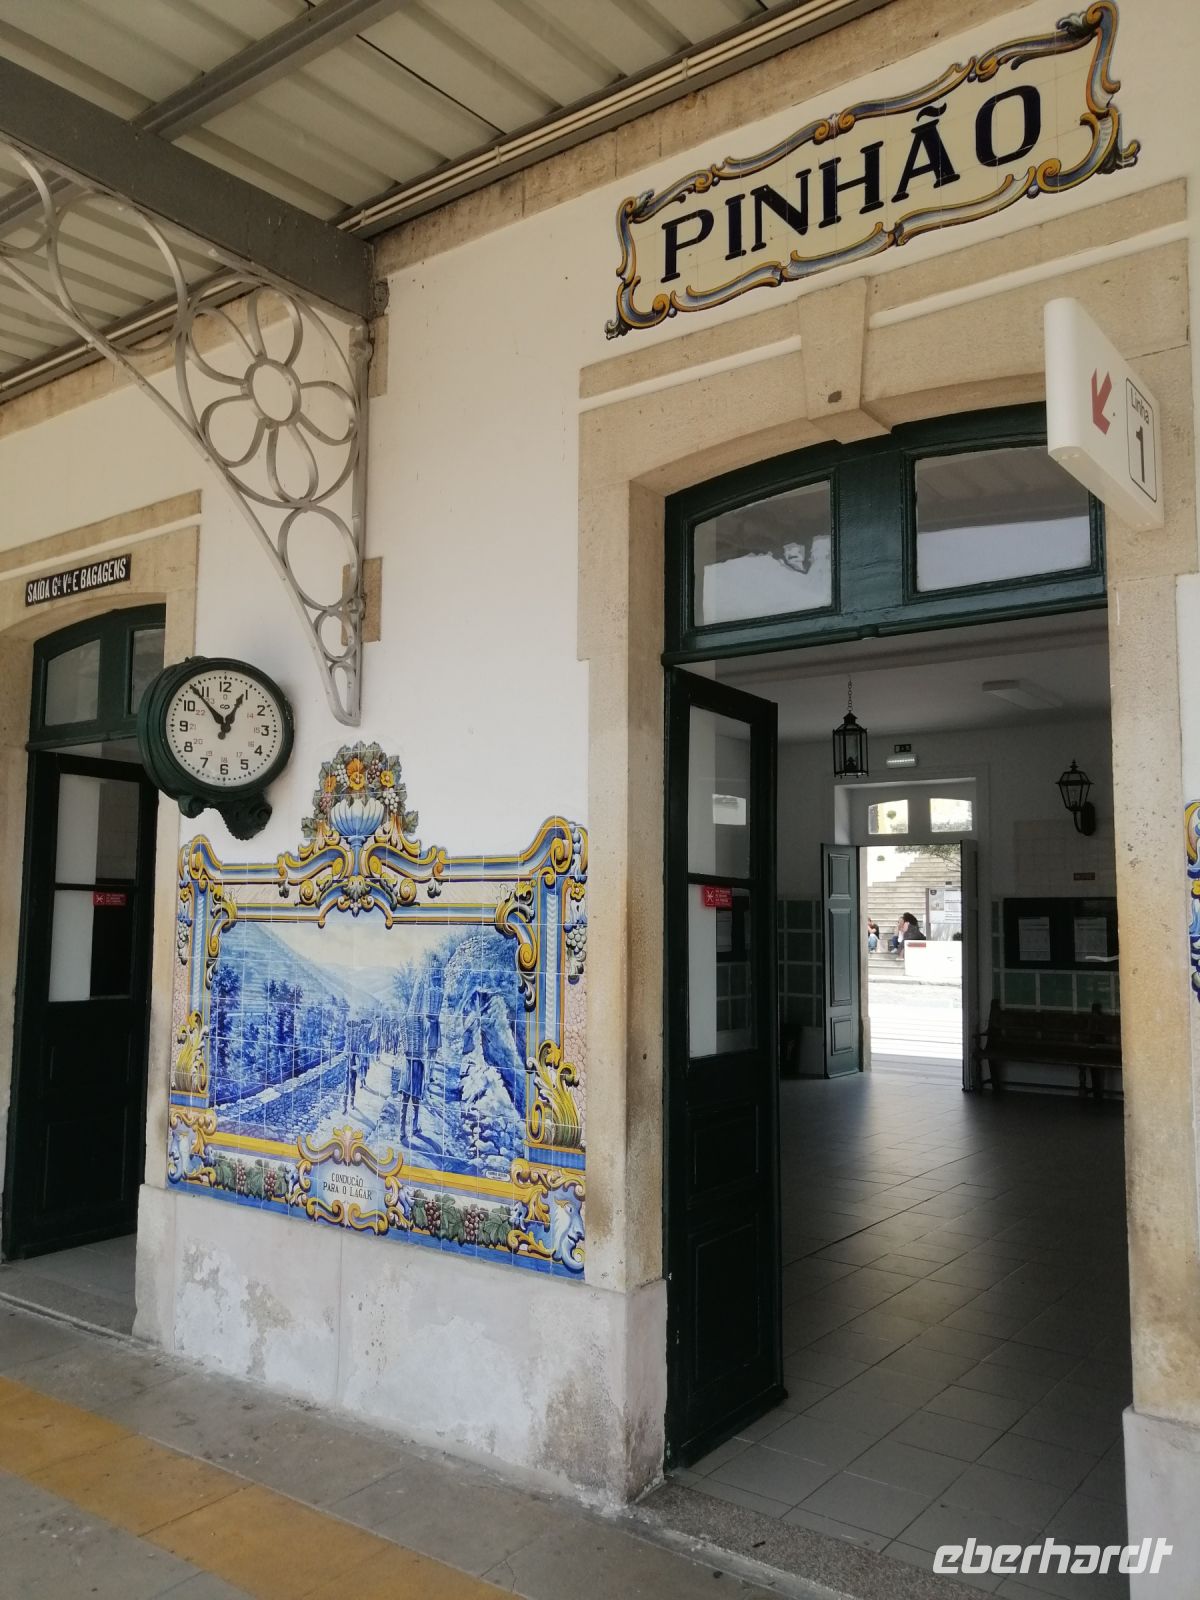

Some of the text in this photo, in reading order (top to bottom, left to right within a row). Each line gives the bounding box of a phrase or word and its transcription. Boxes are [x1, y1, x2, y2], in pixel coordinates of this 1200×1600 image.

[659, 83, 1043, 284] PINHÃO
[1130, 387, 1150, 426] Linha
[1135, 425, 1146, 484] 1
[73, 570, 80, 591] E
[80, 558, 126, 589] BAGAGENS
[202, 686, 209, 698] 11
[219, 681, 232, 693] 12
[183, 700, 196, 712] 10
[257, 705, 266, 716] 2
[179, 720, 189, 732] 9
[261, 725, 269, 736] 3
[184, 741, 193, 753] 8
[254, 745, 263, 756] 4
[200, 757, 209, 768] 7
[240, 759, 249, 770] 5
[220, 764, 229, 775] 6
[323, 1181, 372, 1200] PARA O LAGAR
